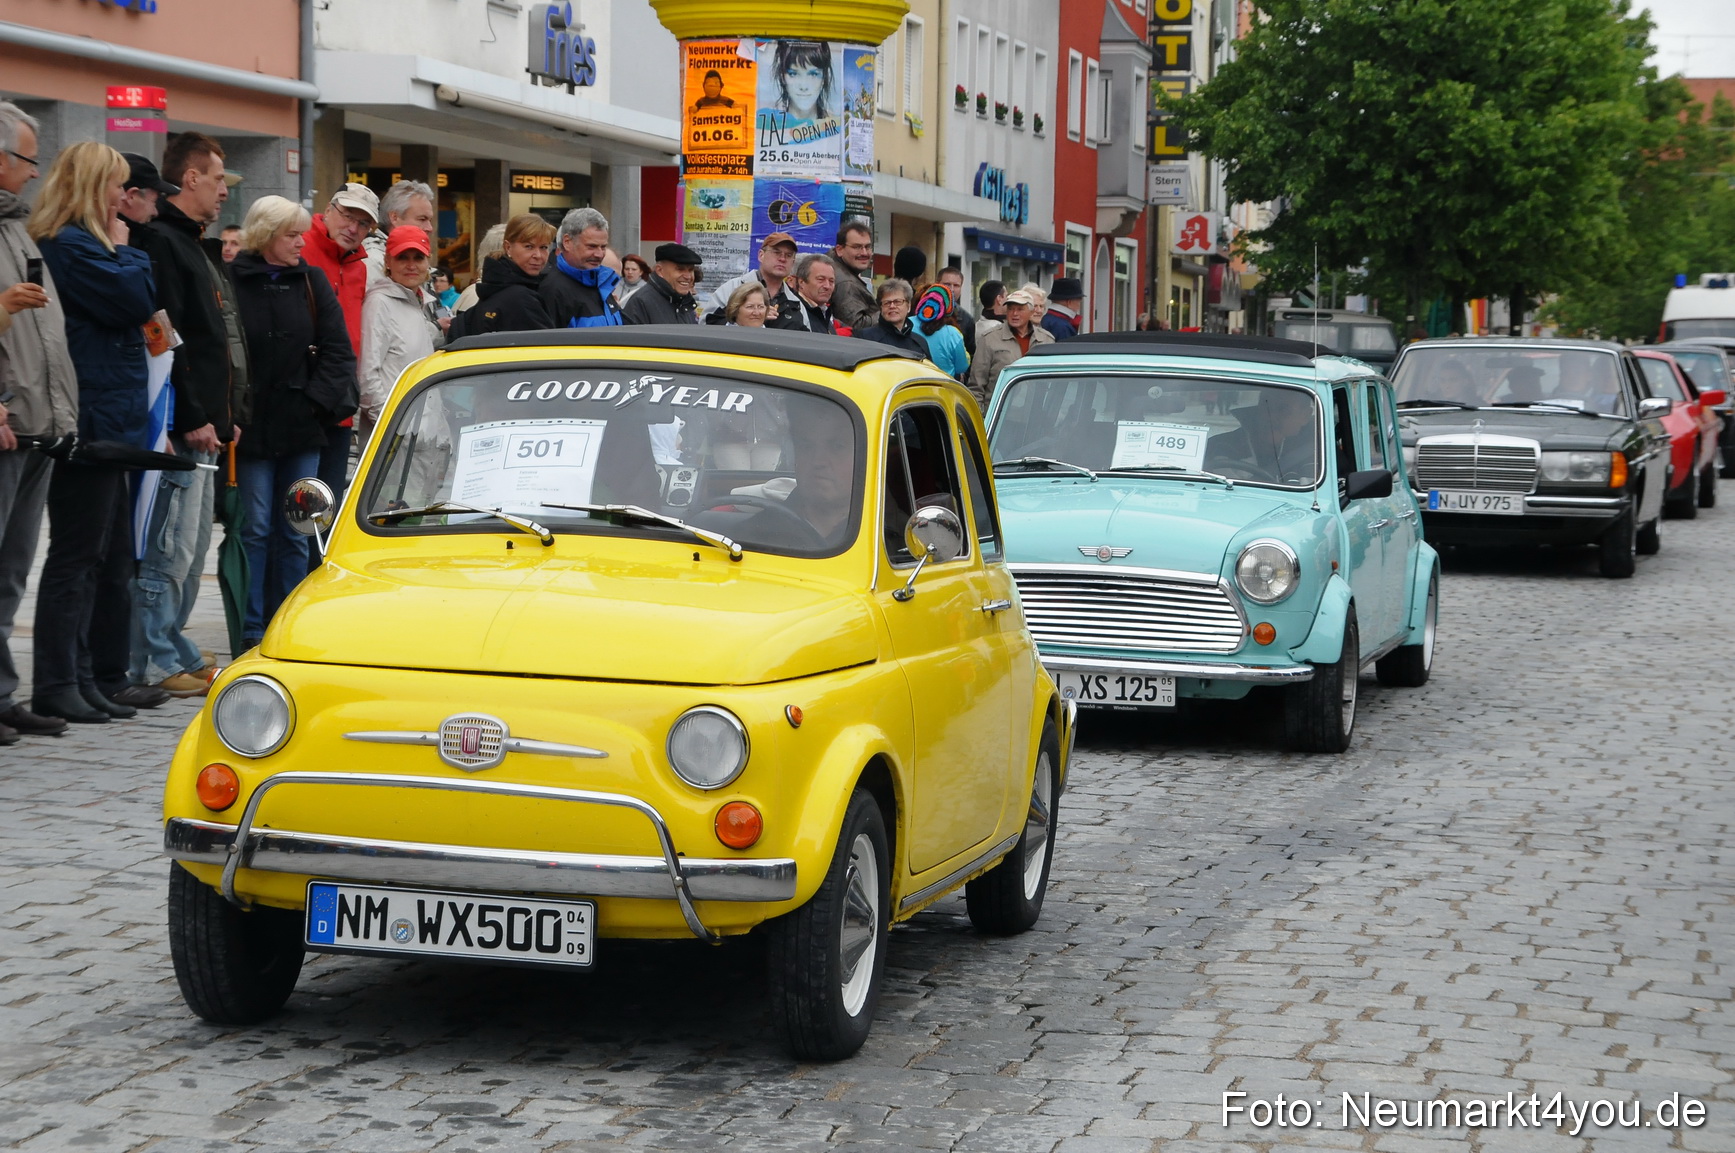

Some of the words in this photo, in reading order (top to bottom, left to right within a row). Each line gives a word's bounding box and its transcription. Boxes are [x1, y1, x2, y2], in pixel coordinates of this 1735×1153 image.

[544, 0, 596, 87] fries
[689, 58, 753, 69] Flohmarkt
[692, 114, 742, 126] Samstag
[692, 129, 739, 142] 01.06.
[759, 111, 788, 148] ZAZ
[792, 124, 821, 144] OPEN
[823, 119, 840, 138] AIR
[686, 154, 747, 165] Volksfestplatz
[759, 150, 793, 162] 25.6.
[794, 151, 810, 159] Burg
[512, 174, 565, 190] FRIES
[1155, 176, 1182, 185] Stern
[685, 222, 705, 231] Sonntag,
[706, 222, 713, 230] 2.
[714, 222, 729, 230] Juni
[730, 223, 749, 232] 2013
[517, 439, 564, 458] 501
[1156, 436, 1186, 450] 489
[1439, 494, 1449, 508] N
[1459, 495, 1479, 509] UY
[1483, 495, 1511, 510] 975
[1079, 674, 1108, 700] XS
[1115, 676, 1158, 702] 125
[1161, 677, 1173, 686] 05
[1162, 695, 1173, 703] 10
[463, 728, 478, 752] FIAT
[336, 893, 389, 941] NM
[566, 910, 586, 924] 04
[317, 920, 328, 933] D
[566, 942, 586, 955] 09
